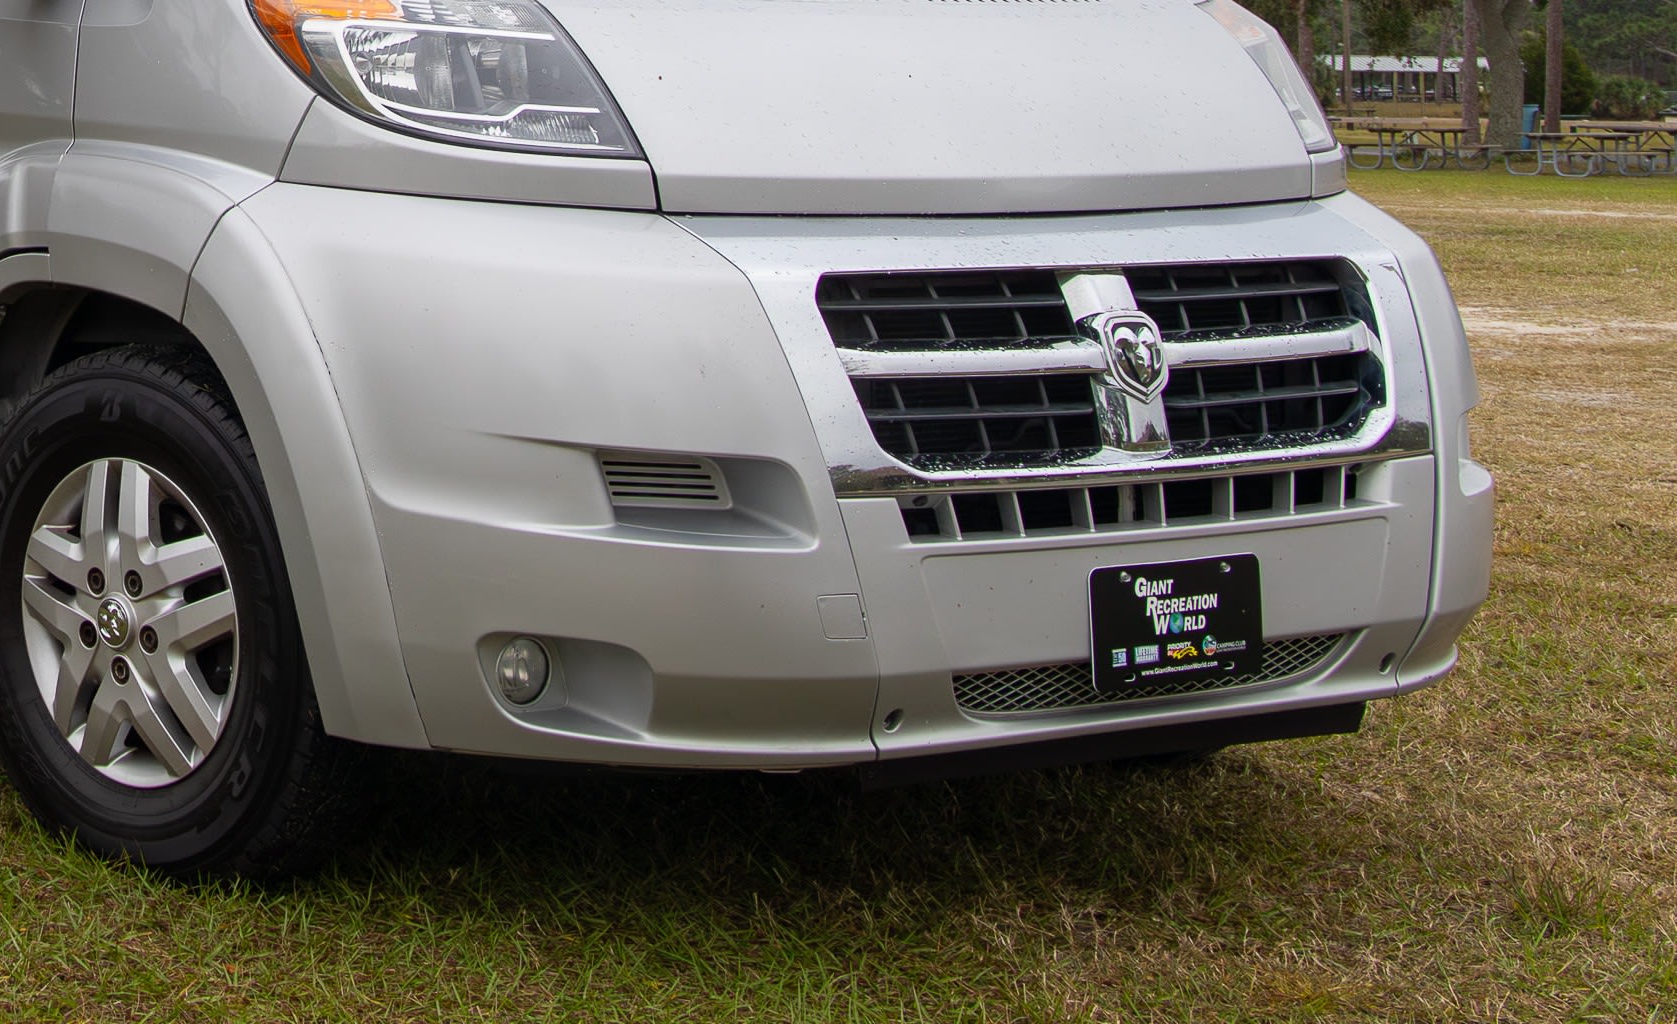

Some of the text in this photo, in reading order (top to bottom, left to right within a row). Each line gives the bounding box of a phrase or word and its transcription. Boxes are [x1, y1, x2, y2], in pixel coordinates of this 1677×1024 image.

[1134, 576, 1174, 597] GIANT
[1146, 593, 1218, 617] RECREATION
[1154, 613, 1207, 635] WORLD
[1166, 641, 1192, 650] PRIORITY
[1141, 660, 1218, 676] www.GiantRecreationWorld.com
